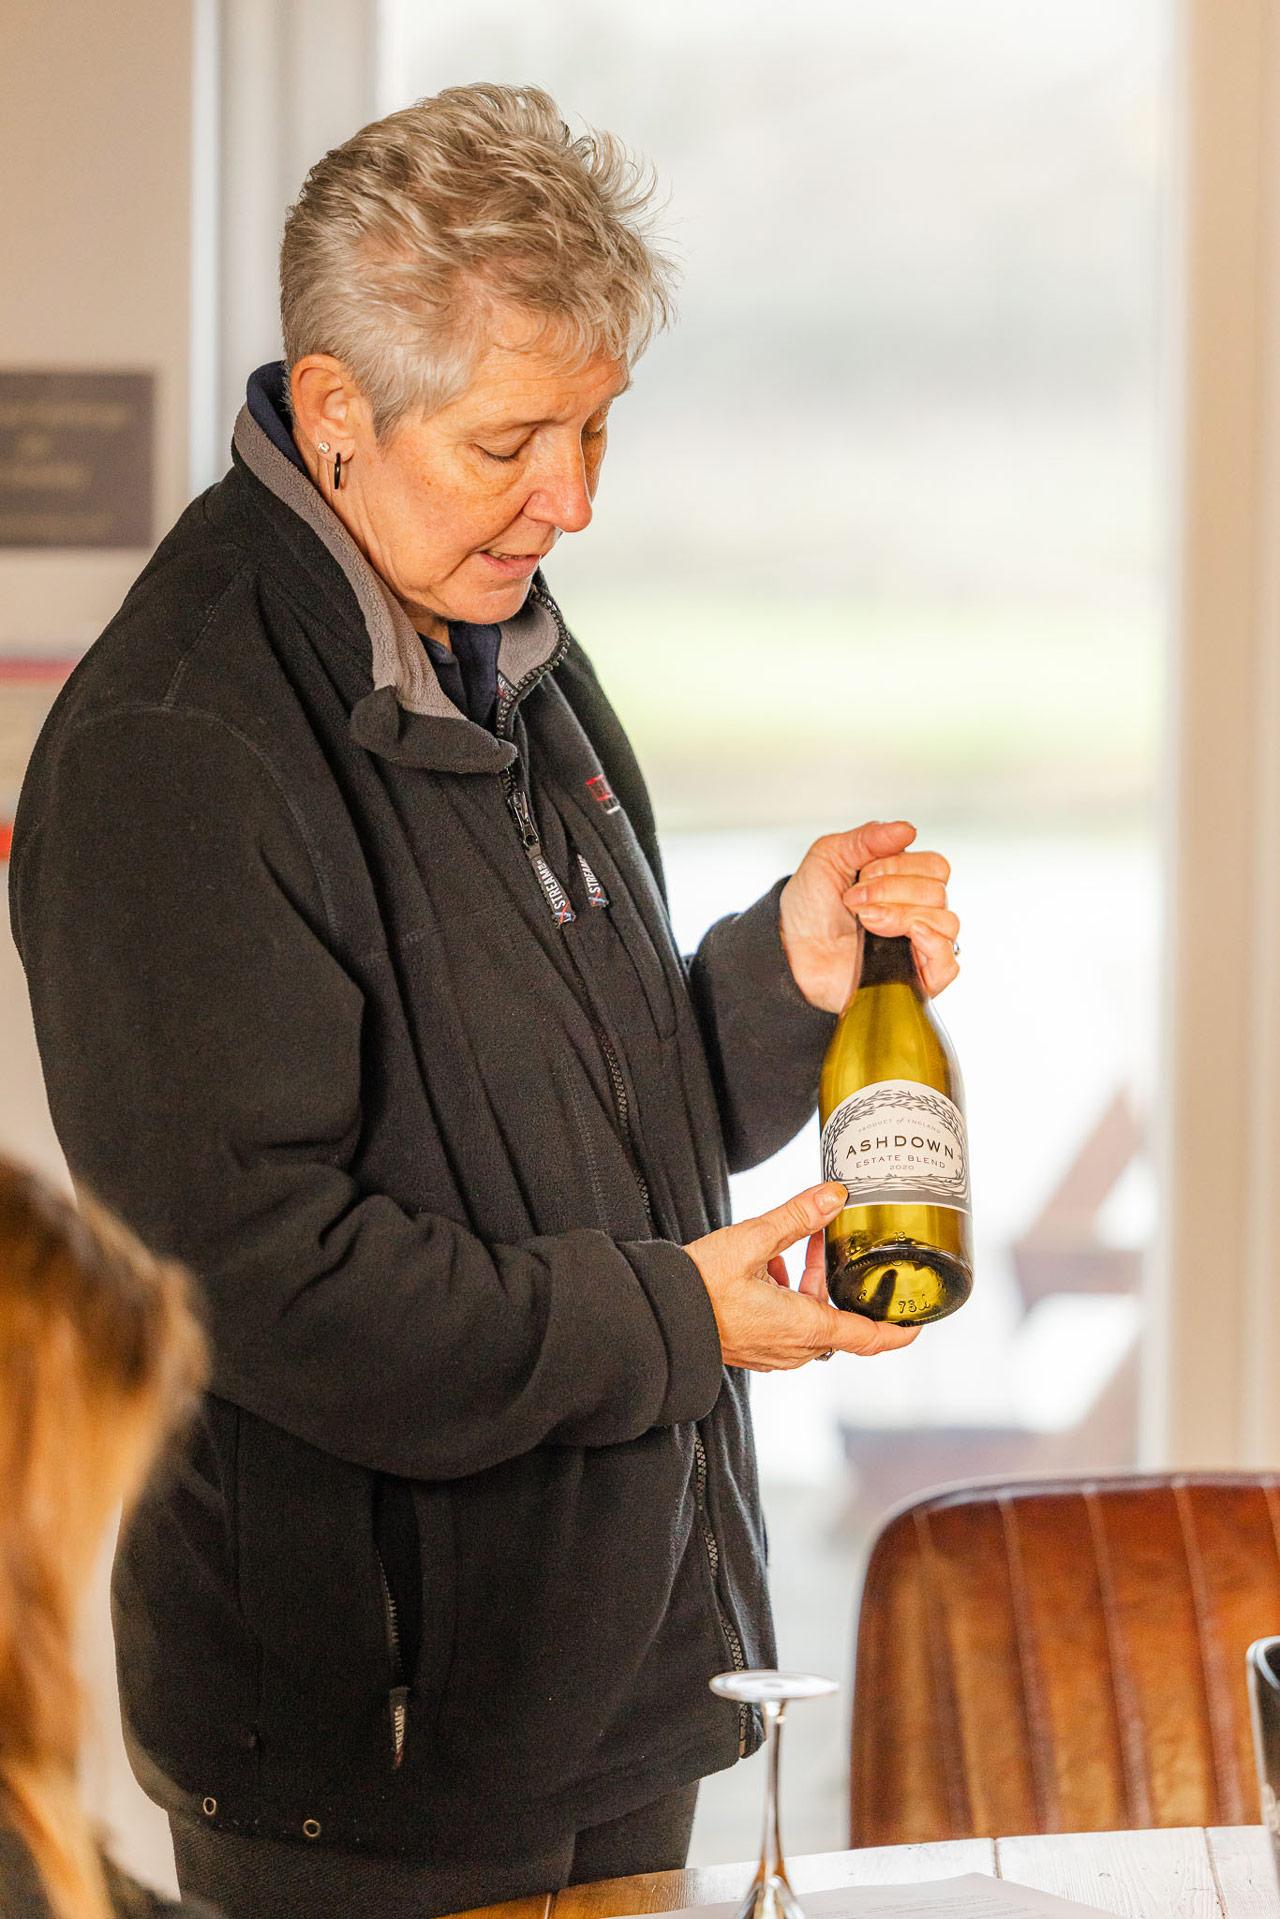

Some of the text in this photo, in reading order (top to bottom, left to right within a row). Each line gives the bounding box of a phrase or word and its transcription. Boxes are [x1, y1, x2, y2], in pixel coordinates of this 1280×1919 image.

[846, 1135, 954, 1160] ASHDOWN
[855, 1154, 946, 1169] ESTATE BLEND
